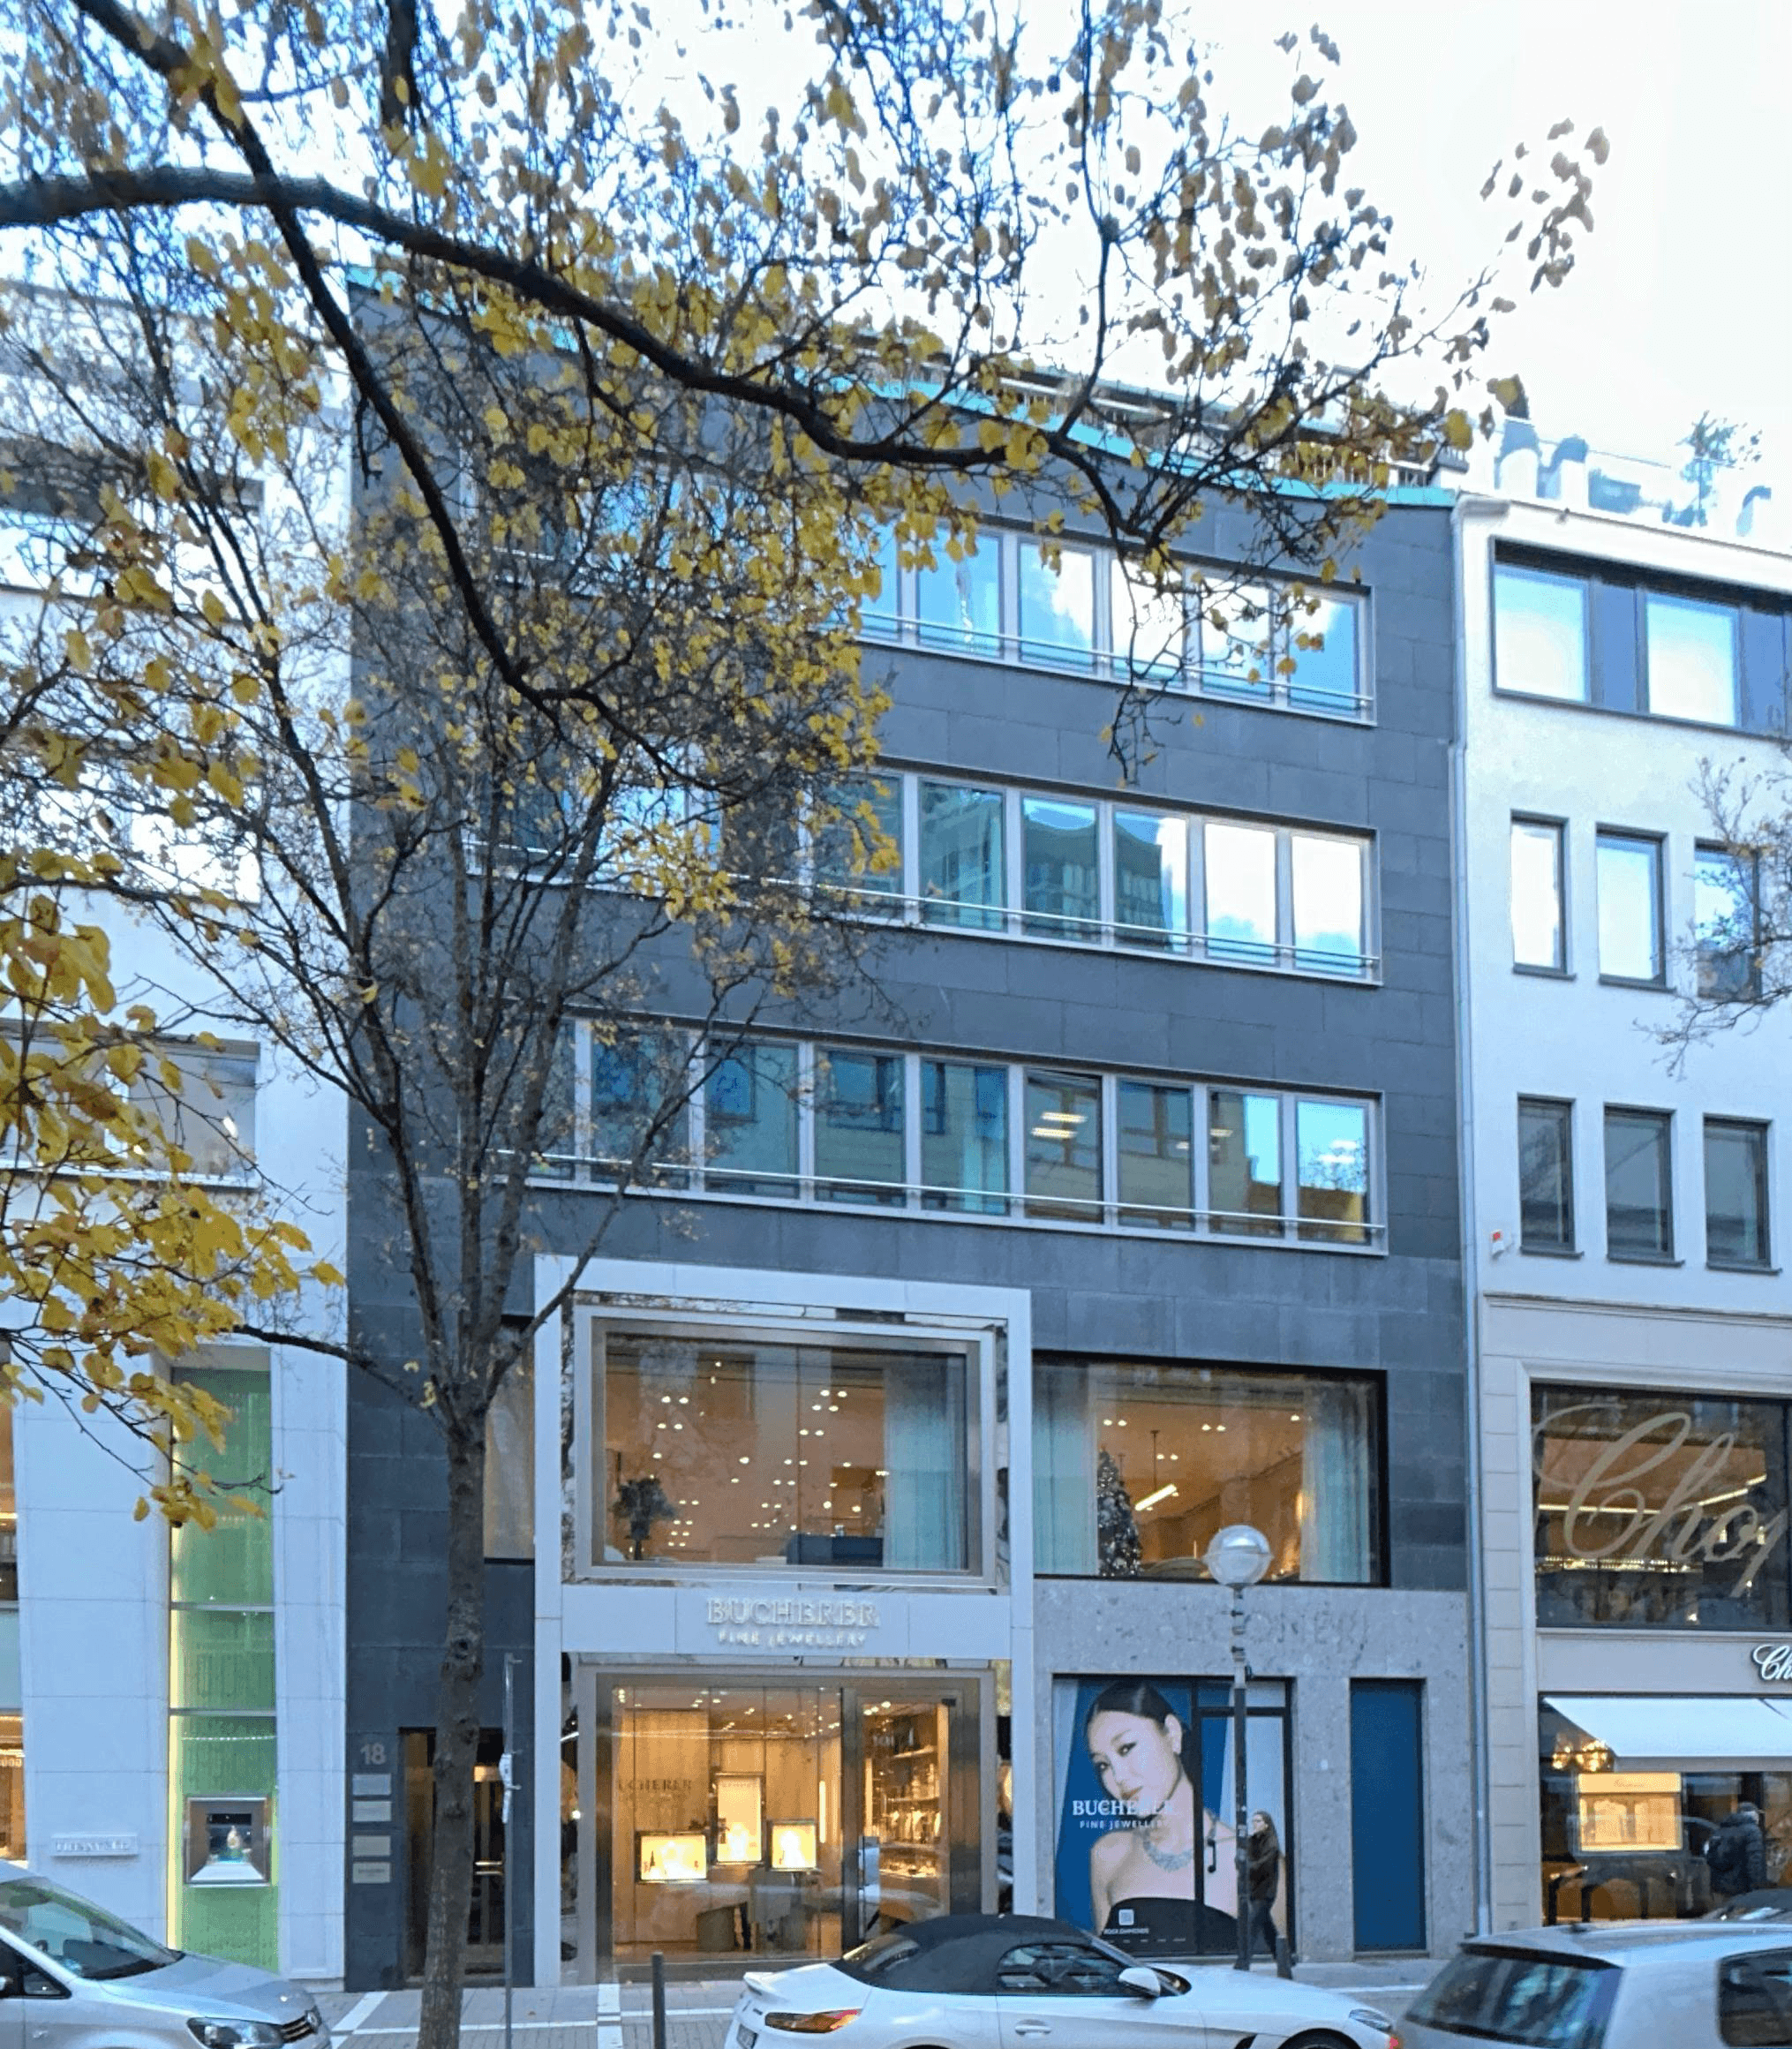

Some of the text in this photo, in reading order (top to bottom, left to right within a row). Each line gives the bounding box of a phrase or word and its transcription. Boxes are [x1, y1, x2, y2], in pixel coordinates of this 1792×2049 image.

[707, 1598, 879, 1628] BUCHERER
[719, 1631, 865, 1648] FINE JEWELLERY
[360, 1743, 387, 1765] 18
[1072, 1798, 1175, 1816] BUCHE
[1079, 1819, 1167, 1830] FINE JEWELLER
